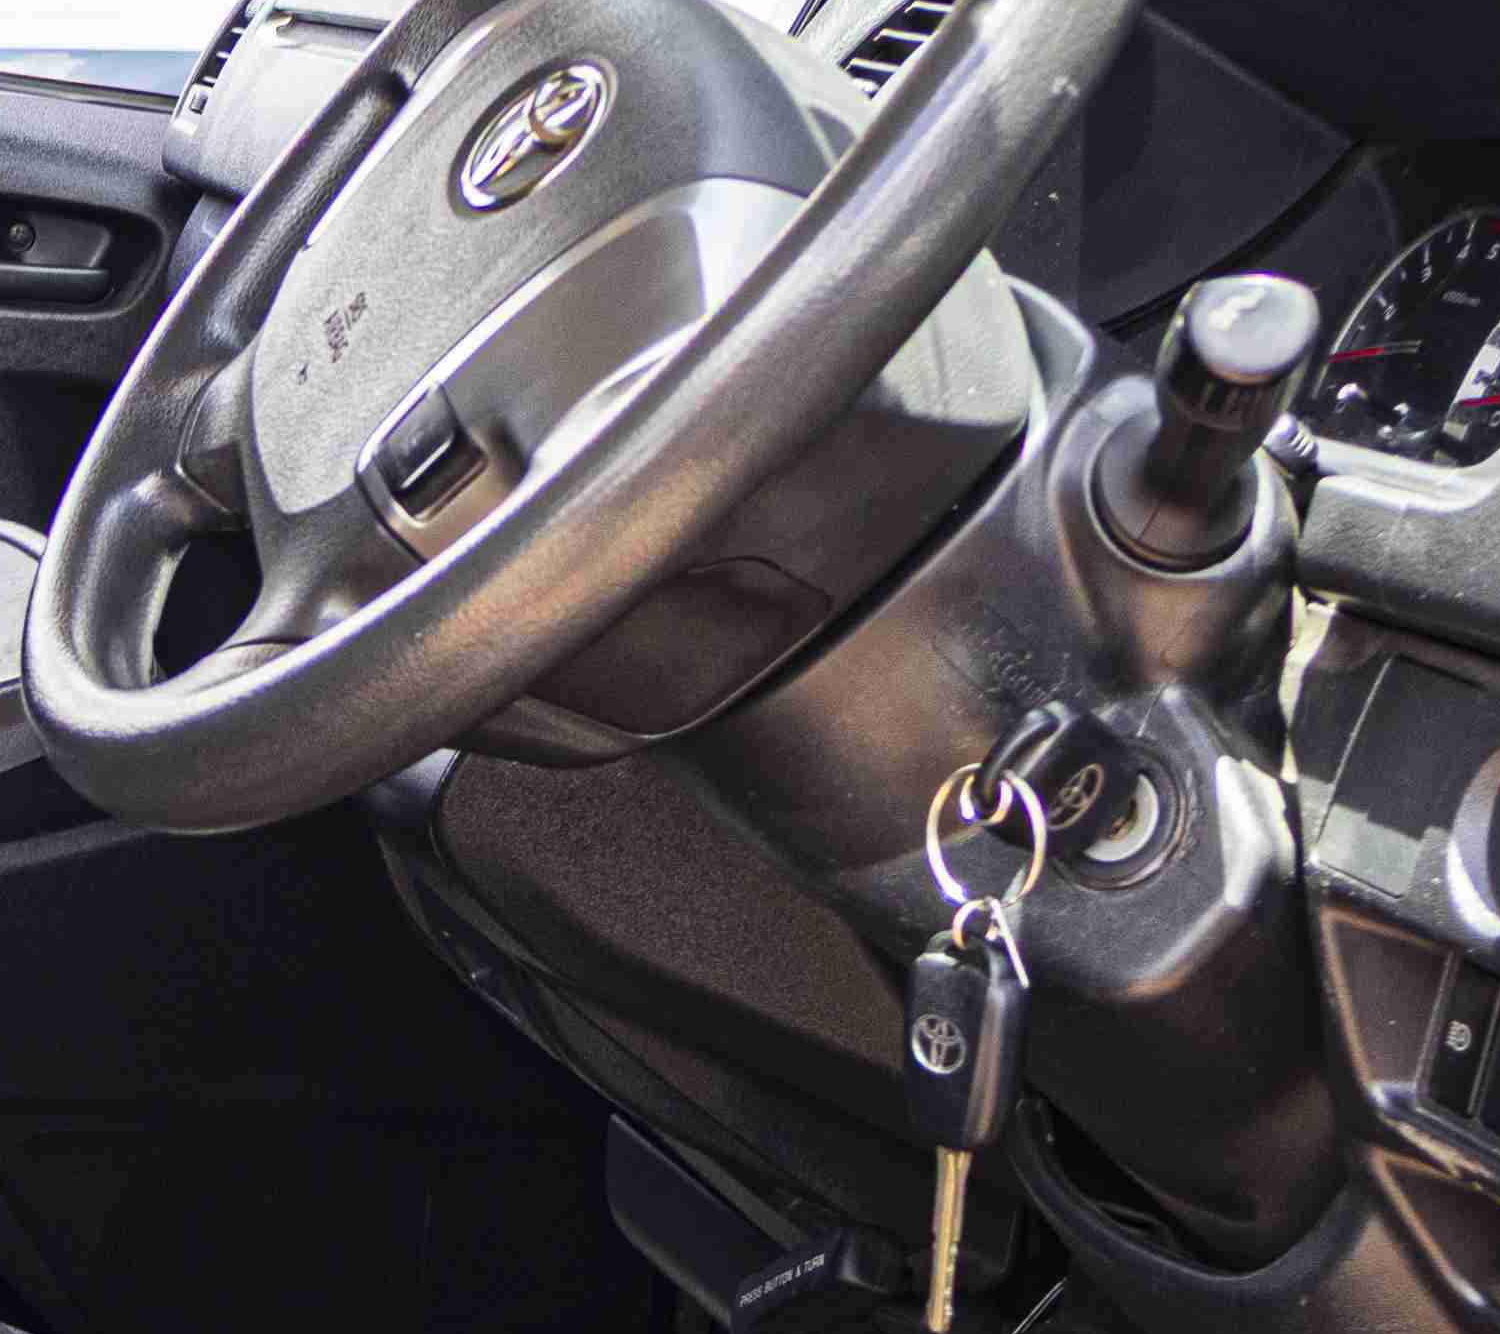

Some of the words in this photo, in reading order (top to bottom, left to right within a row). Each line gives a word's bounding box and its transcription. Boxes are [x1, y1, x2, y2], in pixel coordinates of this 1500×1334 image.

[1420, 265, 1433, 283] 3
[1383, 304, 1399, 322] 2
[803, 1252, 825, 1274] TURN
